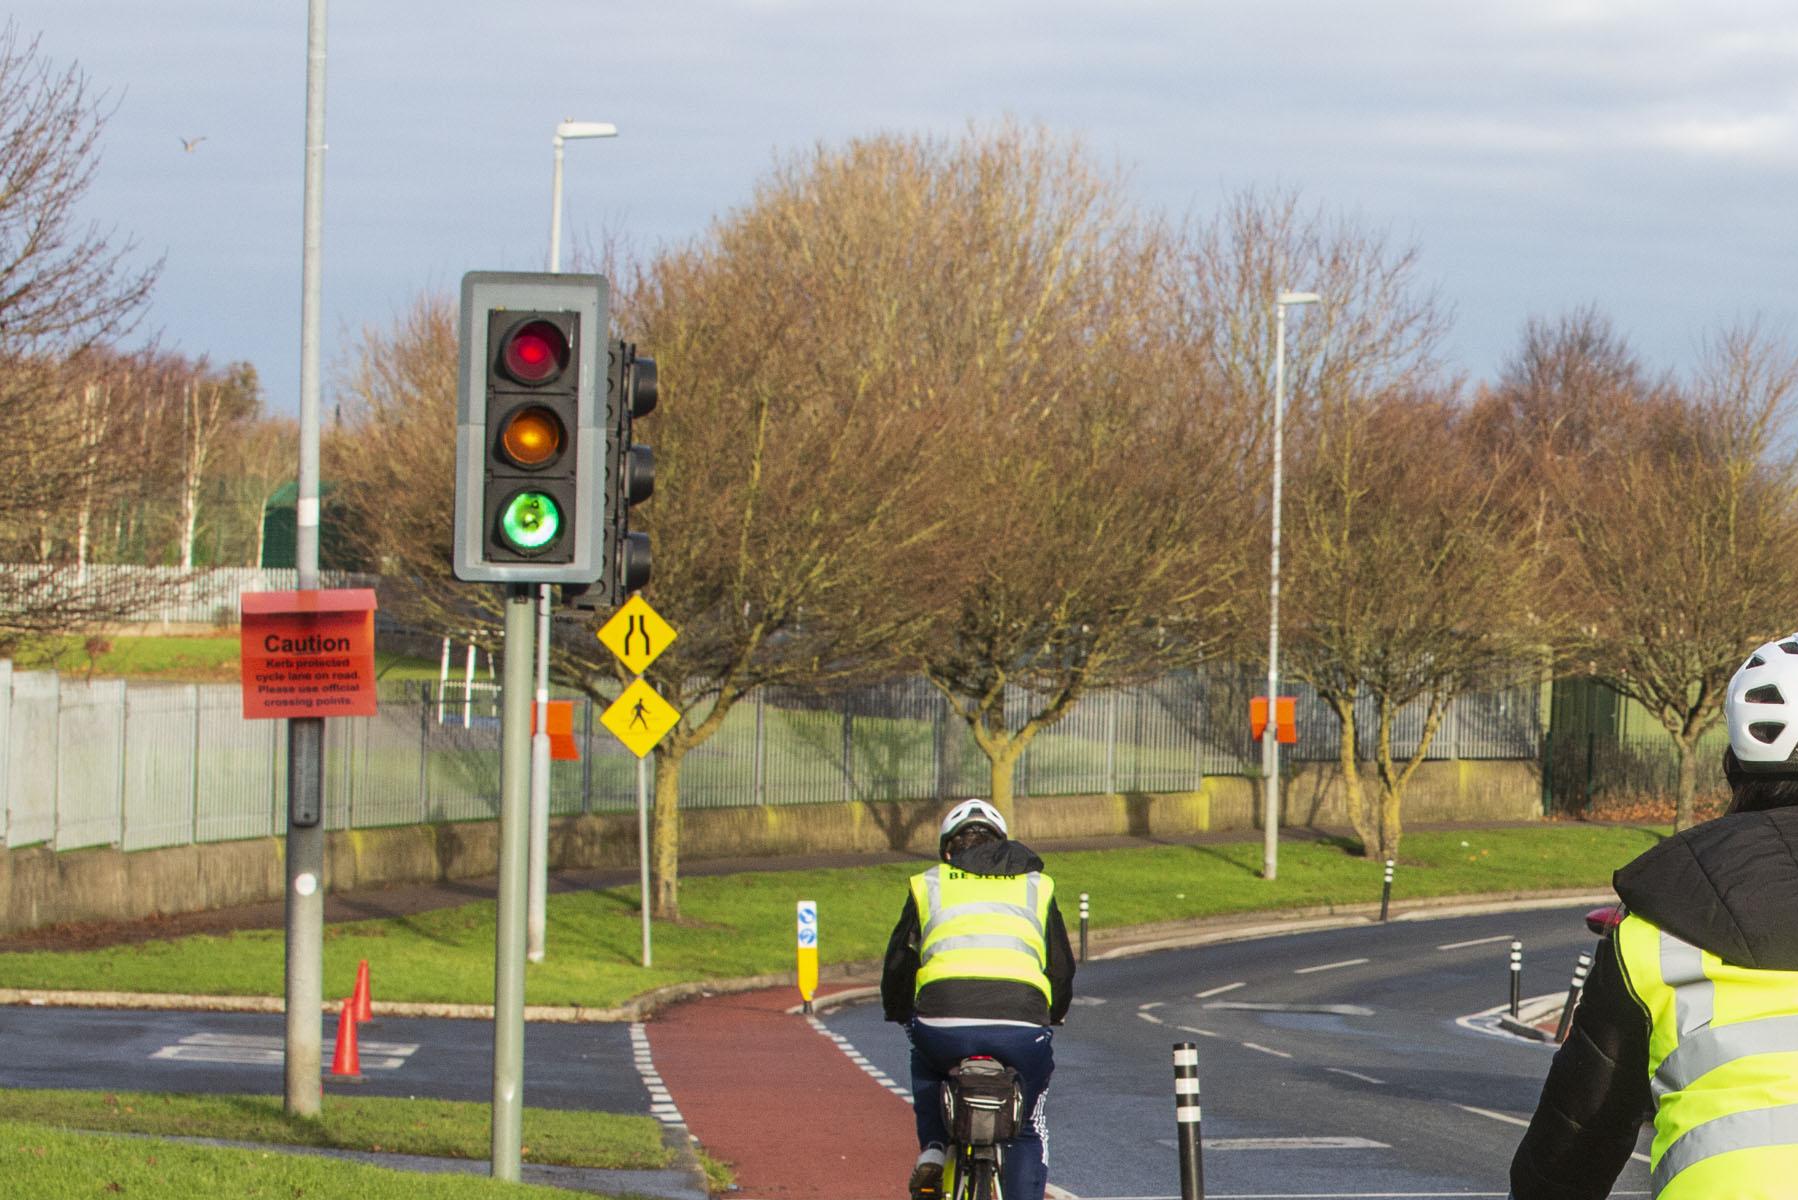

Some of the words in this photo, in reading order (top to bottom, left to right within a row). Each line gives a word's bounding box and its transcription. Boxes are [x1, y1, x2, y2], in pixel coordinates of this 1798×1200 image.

[264, 634, 350, 653] Caution
[266, 659, 293, 668] Kerb
[296, 659, 350, 670] protected
[256, 672, 286, 683] cycle
[288, 671, 311, 680] lane
[314, 672, 329, 680] on
[258, 685, 295, 693] Please
[321, 683, 360, 692] official
[264, 698, 313, 708] crossing
[949, 872, 969, 880] BE
